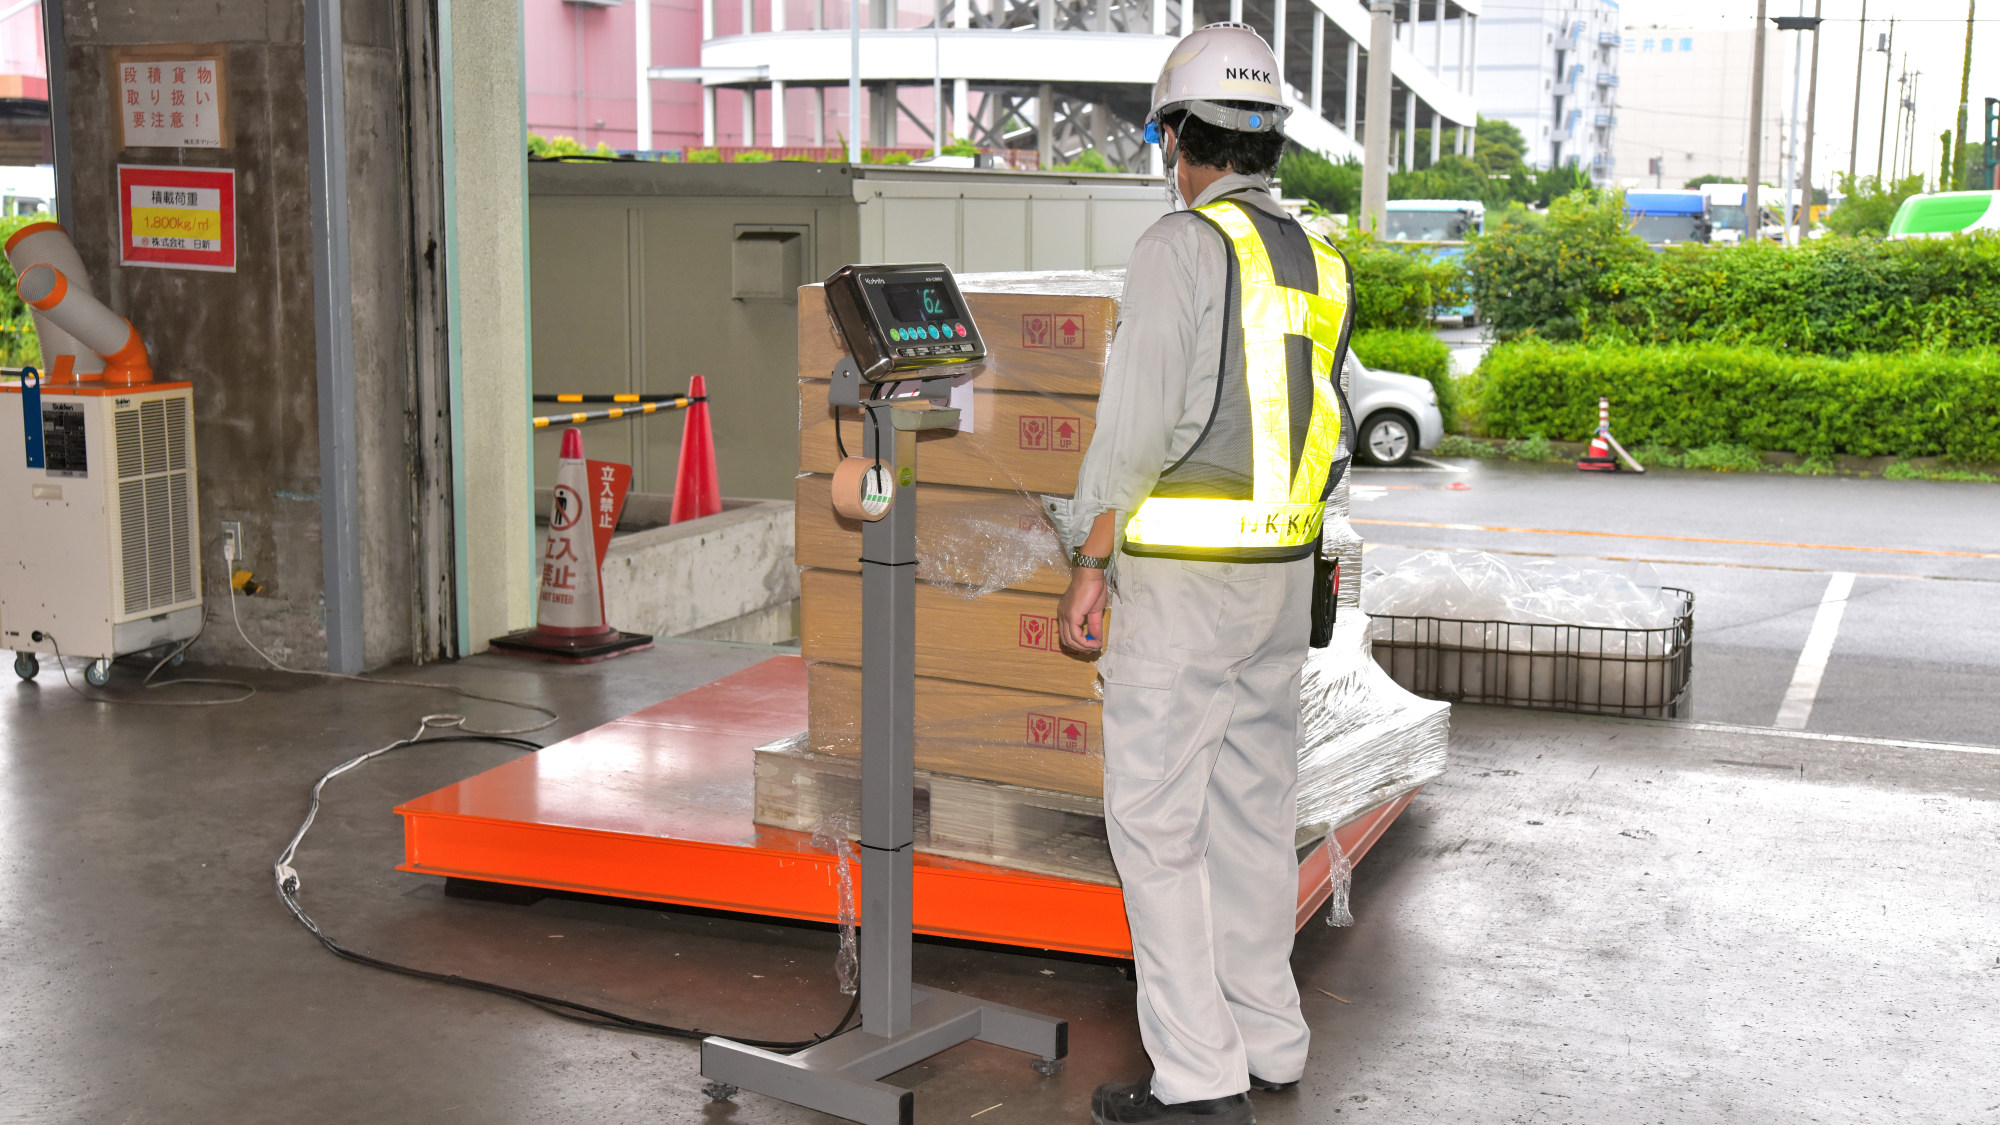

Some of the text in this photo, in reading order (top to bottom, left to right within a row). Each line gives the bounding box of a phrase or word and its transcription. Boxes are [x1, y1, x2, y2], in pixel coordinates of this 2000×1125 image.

[124, 66, 212, 84] 段積貨物
[1226, 67, 1271, 85] NKKK
[127, 89, 210, 106] 取り扱い
[151, 190, 199, 207] 積載荷重
[152, 237, 185, 248] 株式会社
[1063, 336, 1076, 346] UP
[1059, 439, 1072, 449] UP
[599, 465, 615, 528] 立入禁止
[1065, 740, 1078, 749] UP
